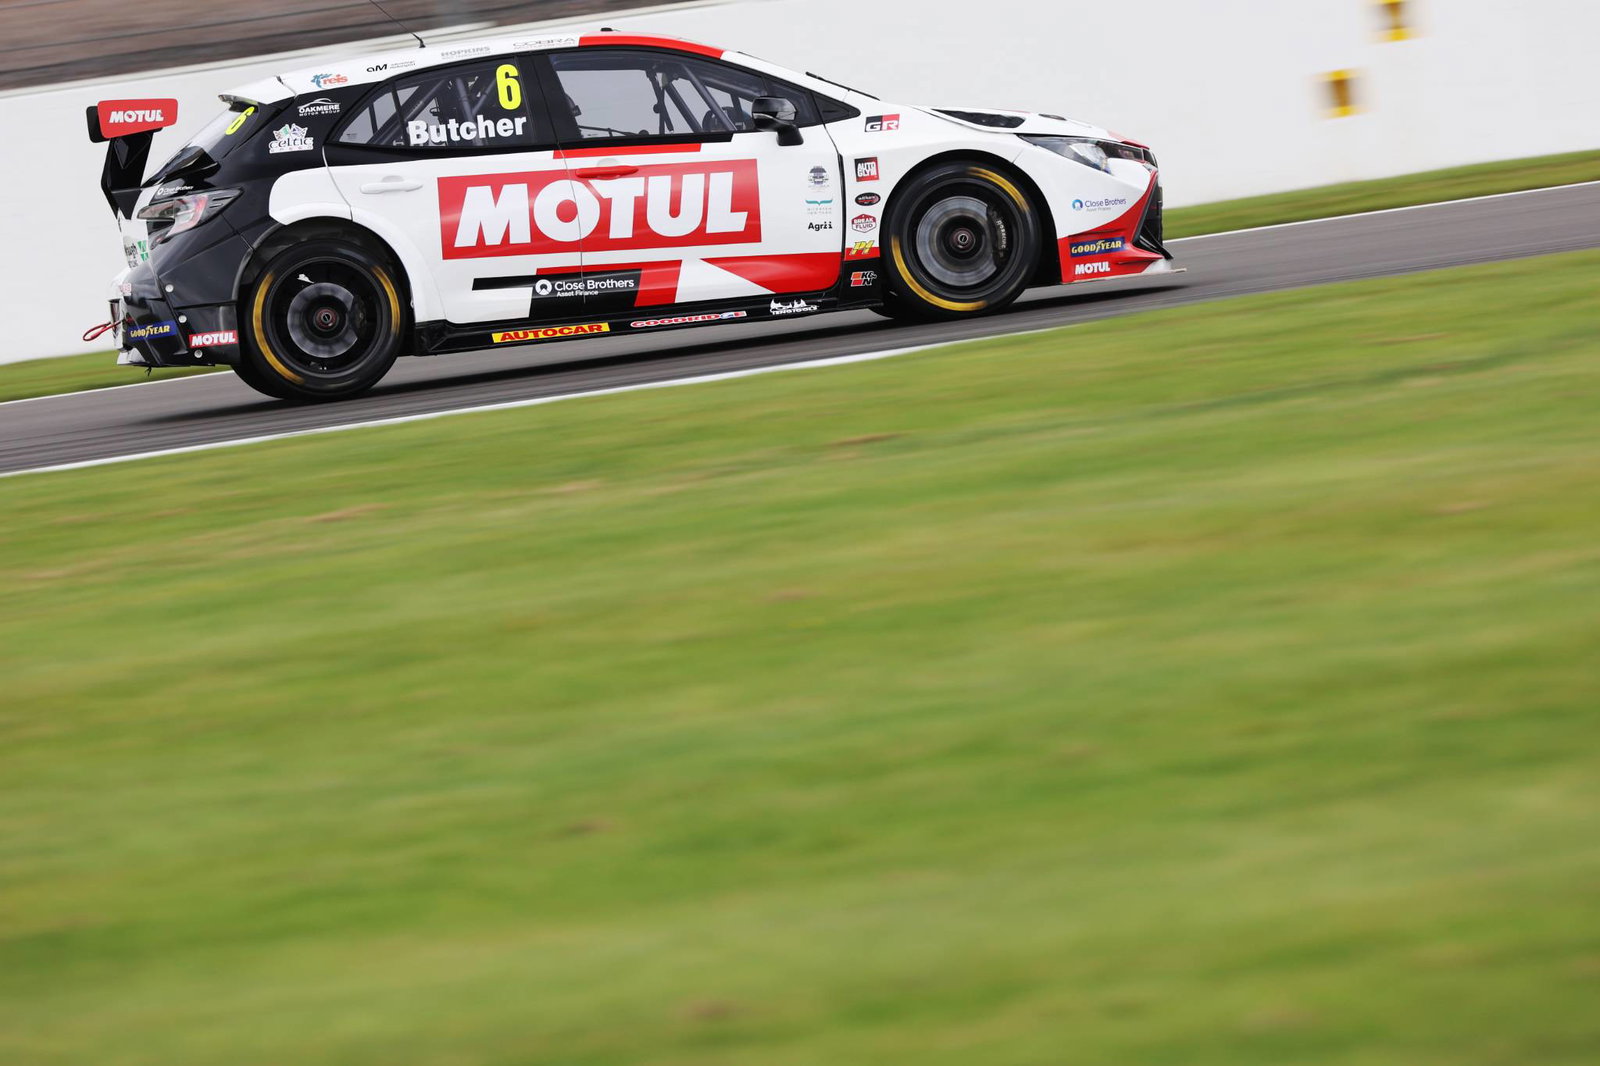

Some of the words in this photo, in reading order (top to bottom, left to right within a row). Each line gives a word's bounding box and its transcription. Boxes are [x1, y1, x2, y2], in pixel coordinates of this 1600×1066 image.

[322, 74, 348, 85] reis
[496, 64, 522, 110] 6
[299, 104, 340, 114] OAKMERE
[109, 109, 164, 124] MOTUL
[225, 106, 255, 135] 6
[408, 115, 527, 146] Butcher
[865, 120, 899, 132] GR
[454, 172, 748, 247] MOTUL
[1084, 200, 1103, 208] Close
[1104, 198, 1127, 206] Brothers
[808, 221, 833, 231] Agrii
[1071, 240, 1122, 253] GOODYEAR
[1075, 261, 1111, 275] MOTUL
[554, 281, 585, 291] Close
[587, 279, 635, 289] Brothers
[130, 325, 171, 338] GOODYEAR
[500, 324, 603, 342] AUTOCAR
[191, 332, 236, 347] MOTUL
